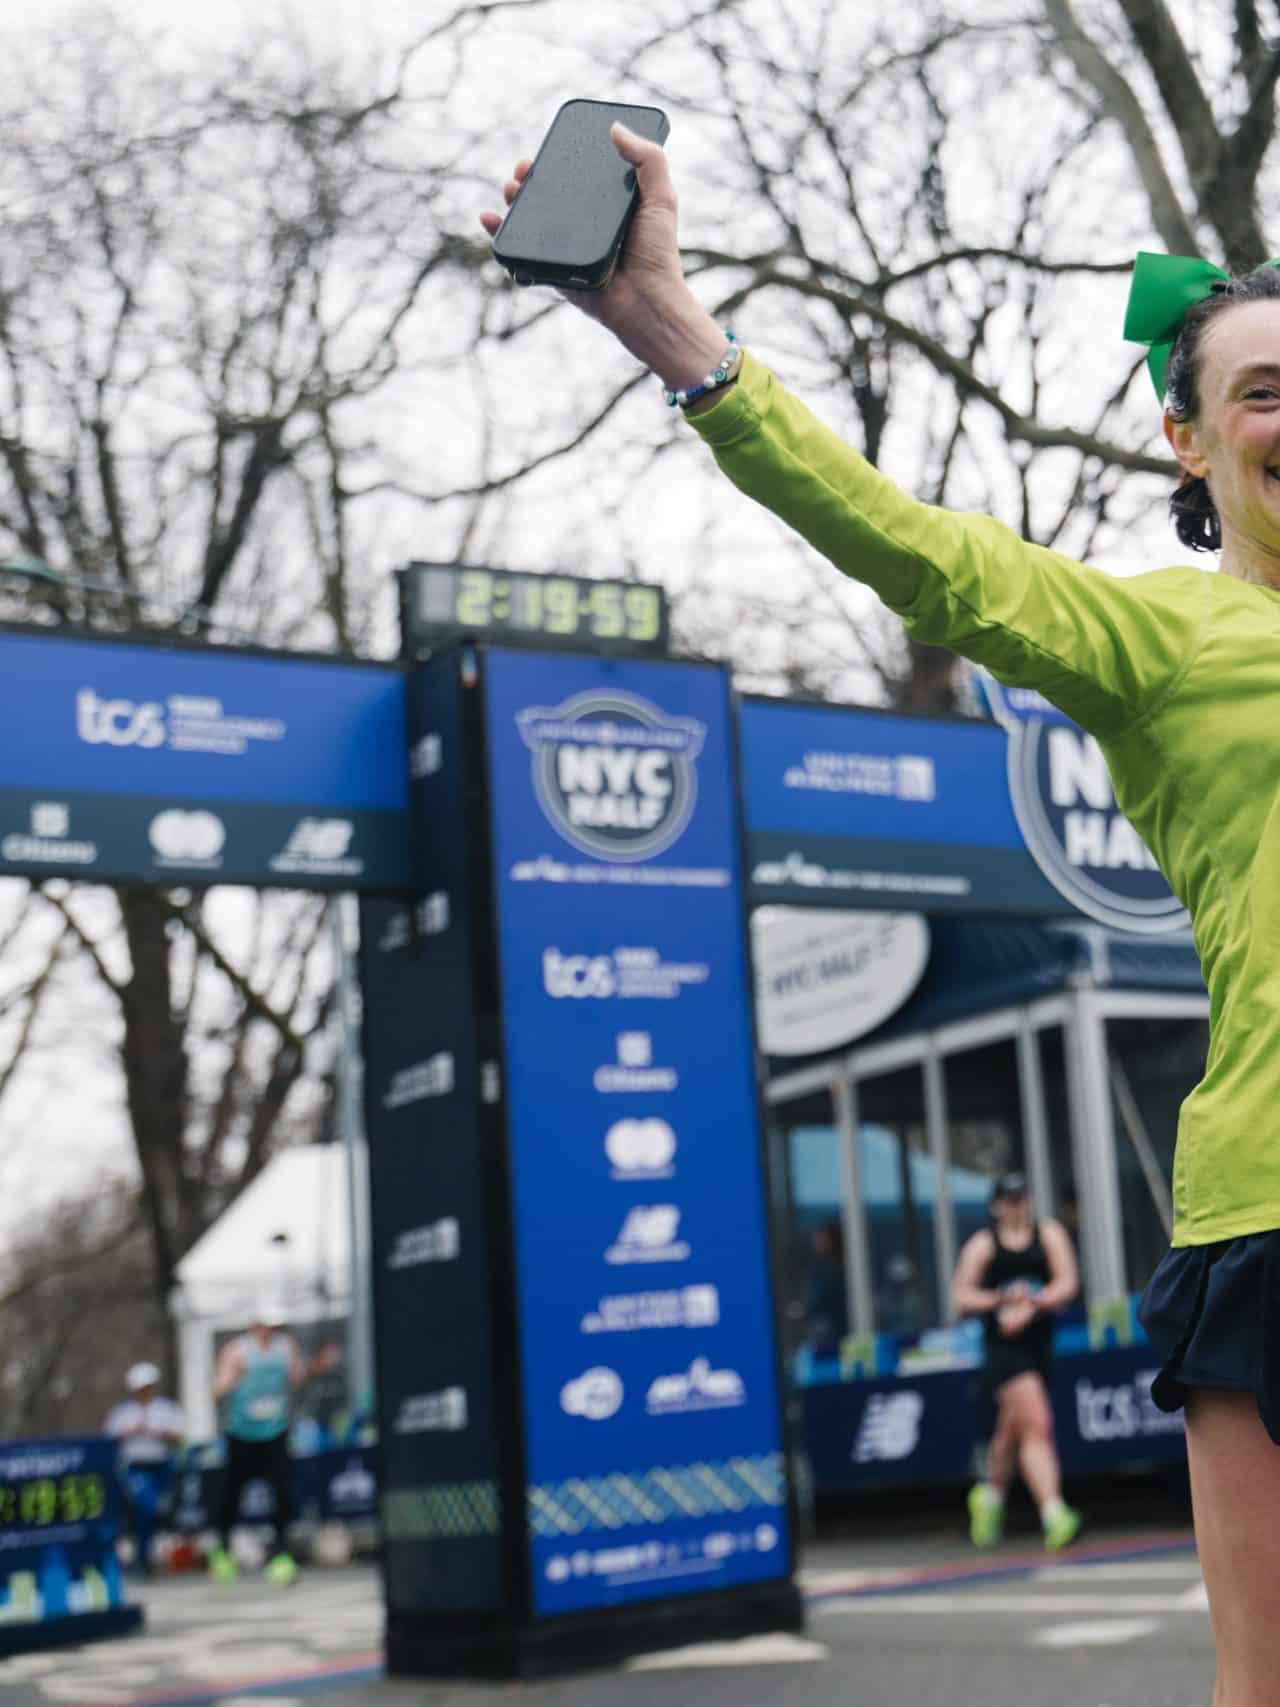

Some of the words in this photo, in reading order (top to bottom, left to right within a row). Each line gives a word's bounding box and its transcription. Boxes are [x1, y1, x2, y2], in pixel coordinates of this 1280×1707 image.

[76, 686, 165, 748] tcs
[557, 744, 673, 798] NYC
[568, 793, 664, 830] HALF
